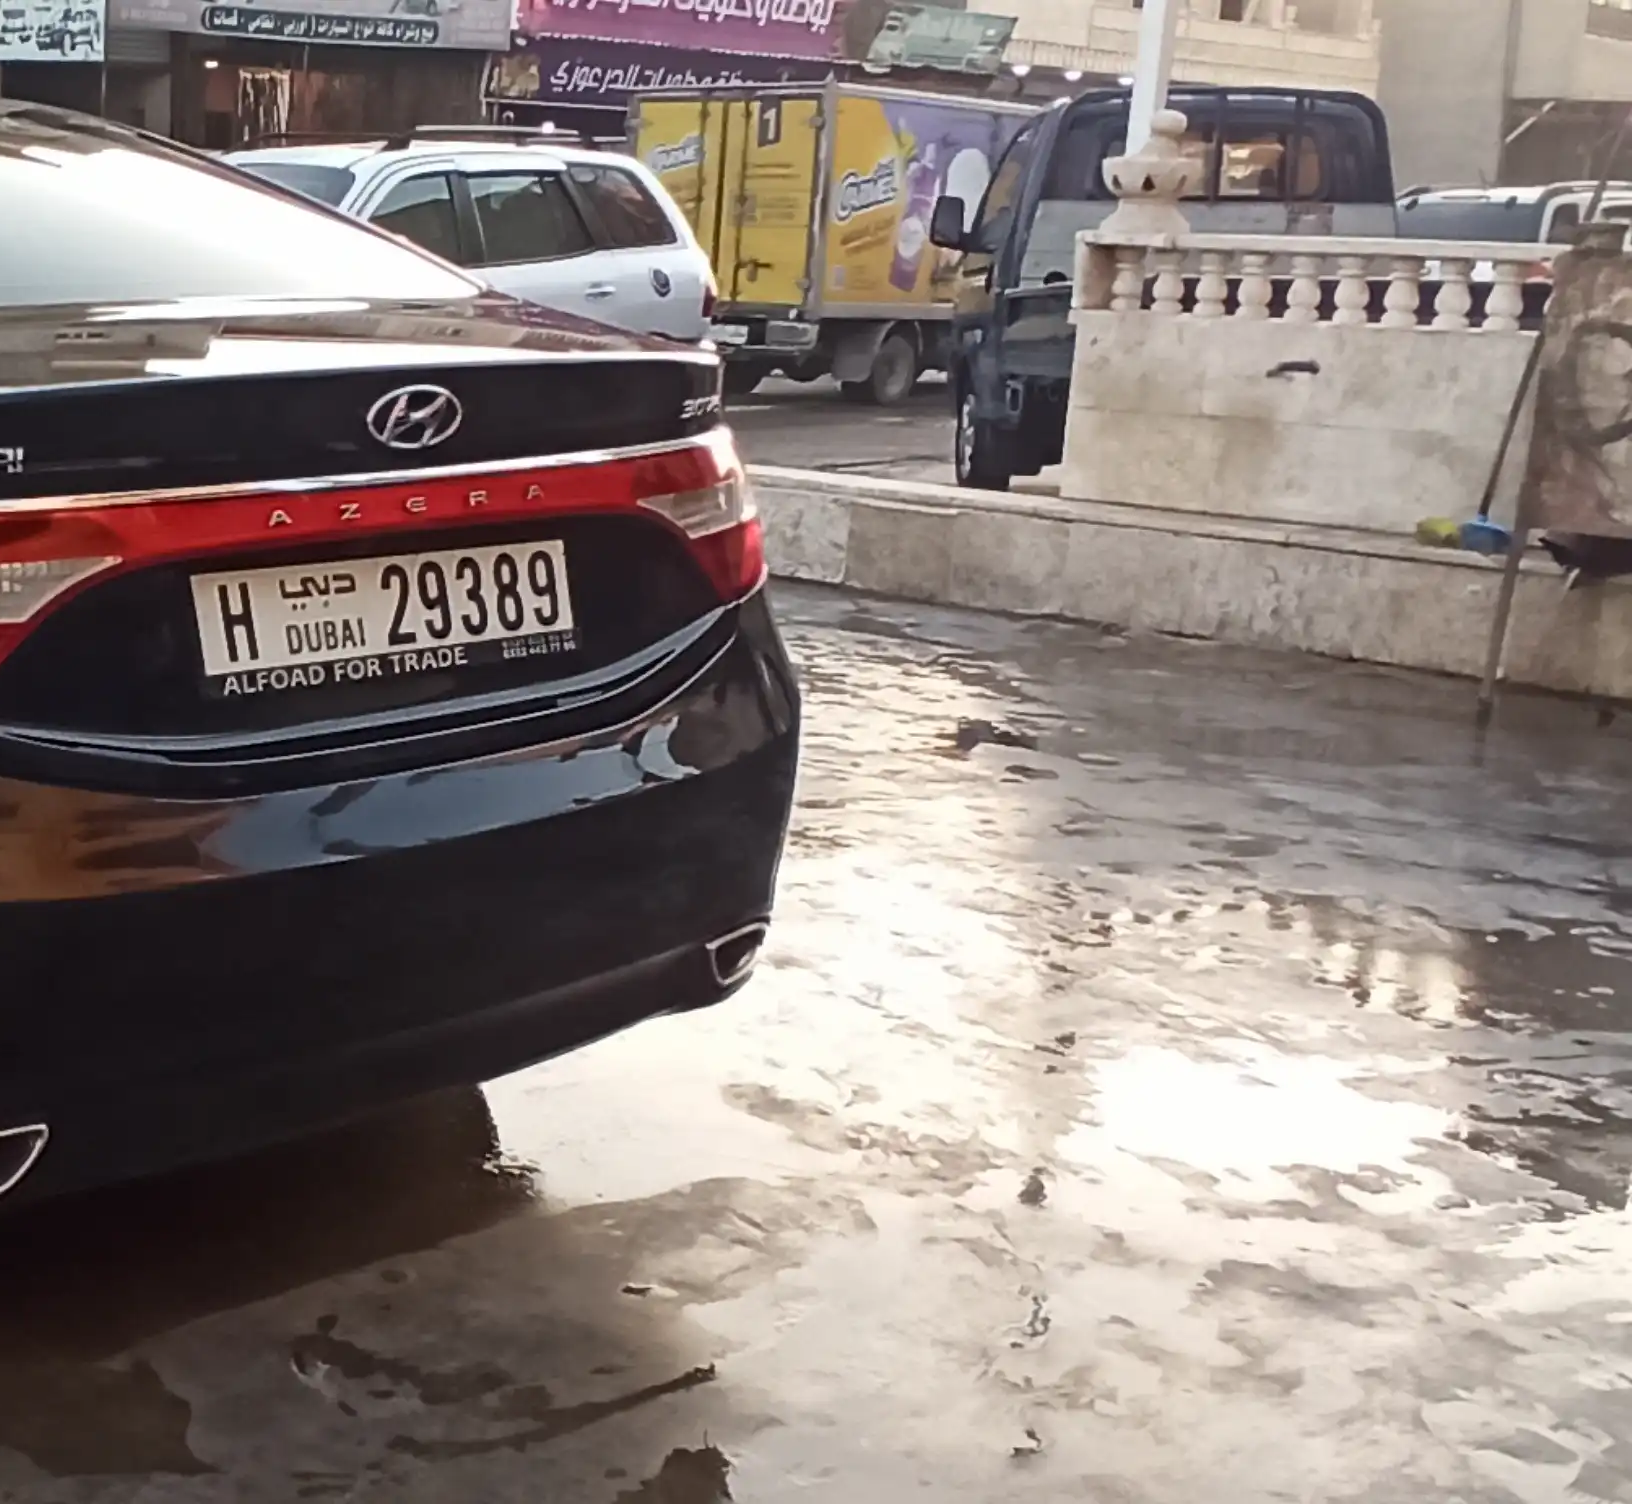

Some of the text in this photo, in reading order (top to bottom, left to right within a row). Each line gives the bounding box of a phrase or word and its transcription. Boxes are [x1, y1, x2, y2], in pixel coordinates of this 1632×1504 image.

[763, 108, 777, 141] 1
[268, 484, 545, 527] AZERA
[278, 573, 357, 611] دبي
[379, 550, 560, 647] 29389
[218, 582, 260, 663] H
[285, 617, 367, 656] DUBAI
[223, 646, 469, 697] ALFOAD FOR TRADE
